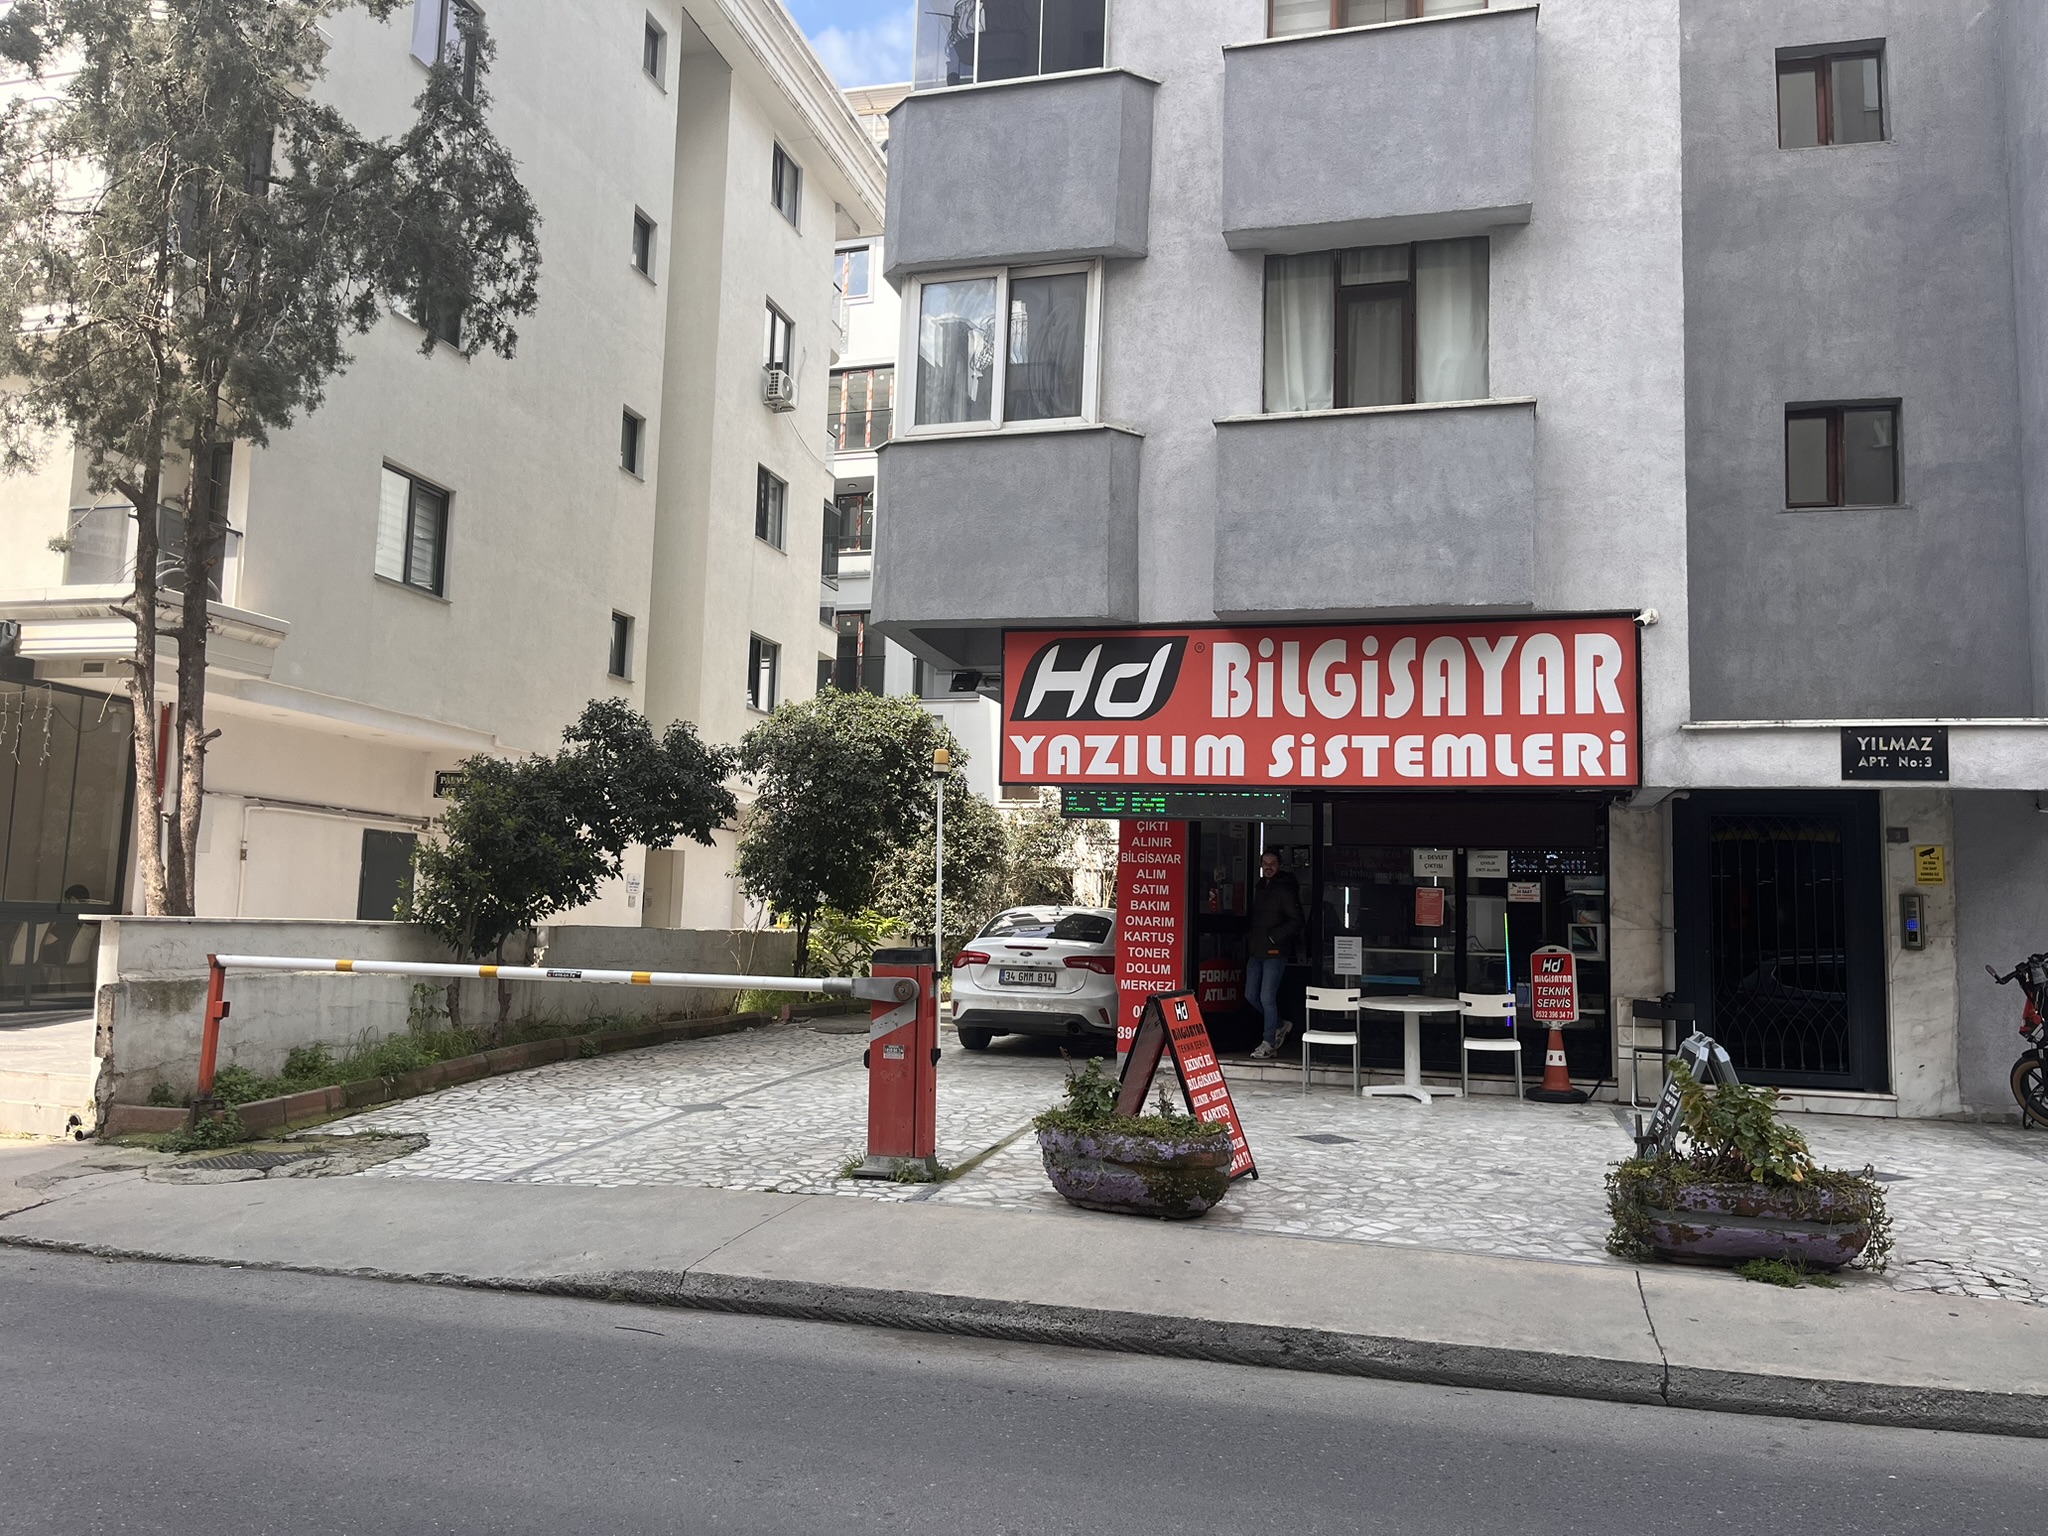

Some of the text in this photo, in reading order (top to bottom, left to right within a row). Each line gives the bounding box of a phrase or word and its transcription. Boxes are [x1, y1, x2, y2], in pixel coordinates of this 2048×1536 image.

[1024, 642, 1173, 718] Hd
[1856, 736, 1933, 751] YILMAZ
[1009, 734, 1245, 776] YAZILIM
[1858, 756, 1933, 768] APT. No:3
[1136, 821, 1169, 833] ÇIKTI
[1131, 837, 1172, 848] ALINIR
[1121, 850, 1181, 864] BİLGİSAYAR
[1136, 869, 1166, 880] ALIM
[1132, 884, 1170, 895] SATIM
[1130, 900, 1170, 911] BAKIM
[1125, 916, 1175, 928] ONARIM
[1124, 931, 1175, 945] KARTUŞ
[1128, 947, 1170, 959] TONER
[1126, 963, 1171, 975] DOLUM
[1005, 971, 1053, 982] 34 GMM 814
[1199, 969, 1242, 984] FORMAT
[1120, 978, 1176, 991] MERKEZİ
[1537, 985, 1571, 996] TEKNİK
[1204, 988, 1237, 1002] ATILIR
[1537, 998, 1571, 1008] SERVİS
